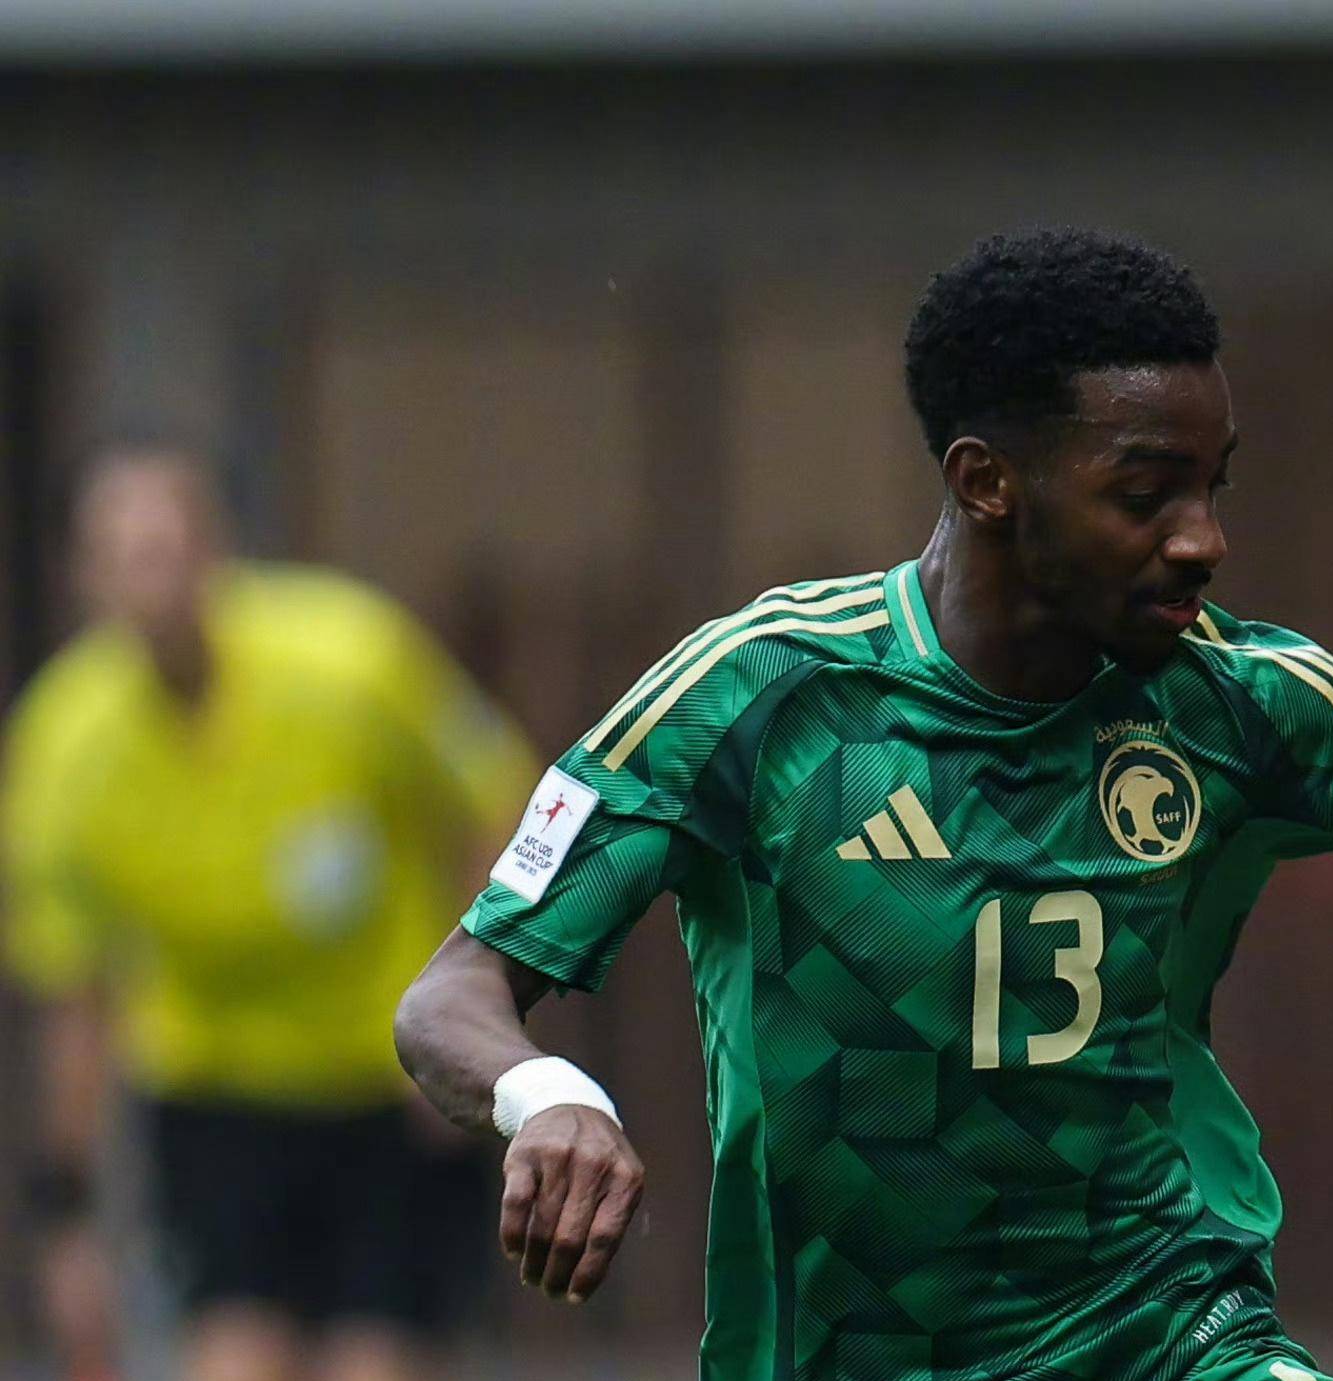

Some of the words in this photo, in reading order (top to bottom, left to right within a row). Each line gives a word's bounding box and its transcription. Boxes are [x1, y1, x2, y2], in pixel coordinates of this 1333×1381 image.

[1155, 810, 1181, 825] SAFF
[512, 843, 537, 863] ASIAN
[523, 834, 539, 850] AFC
[538, 842, 553, 858] U20
[972, 890, 1104, 1069] 13
[1191, 1290, 1244, 1344] HEAT.RDY
